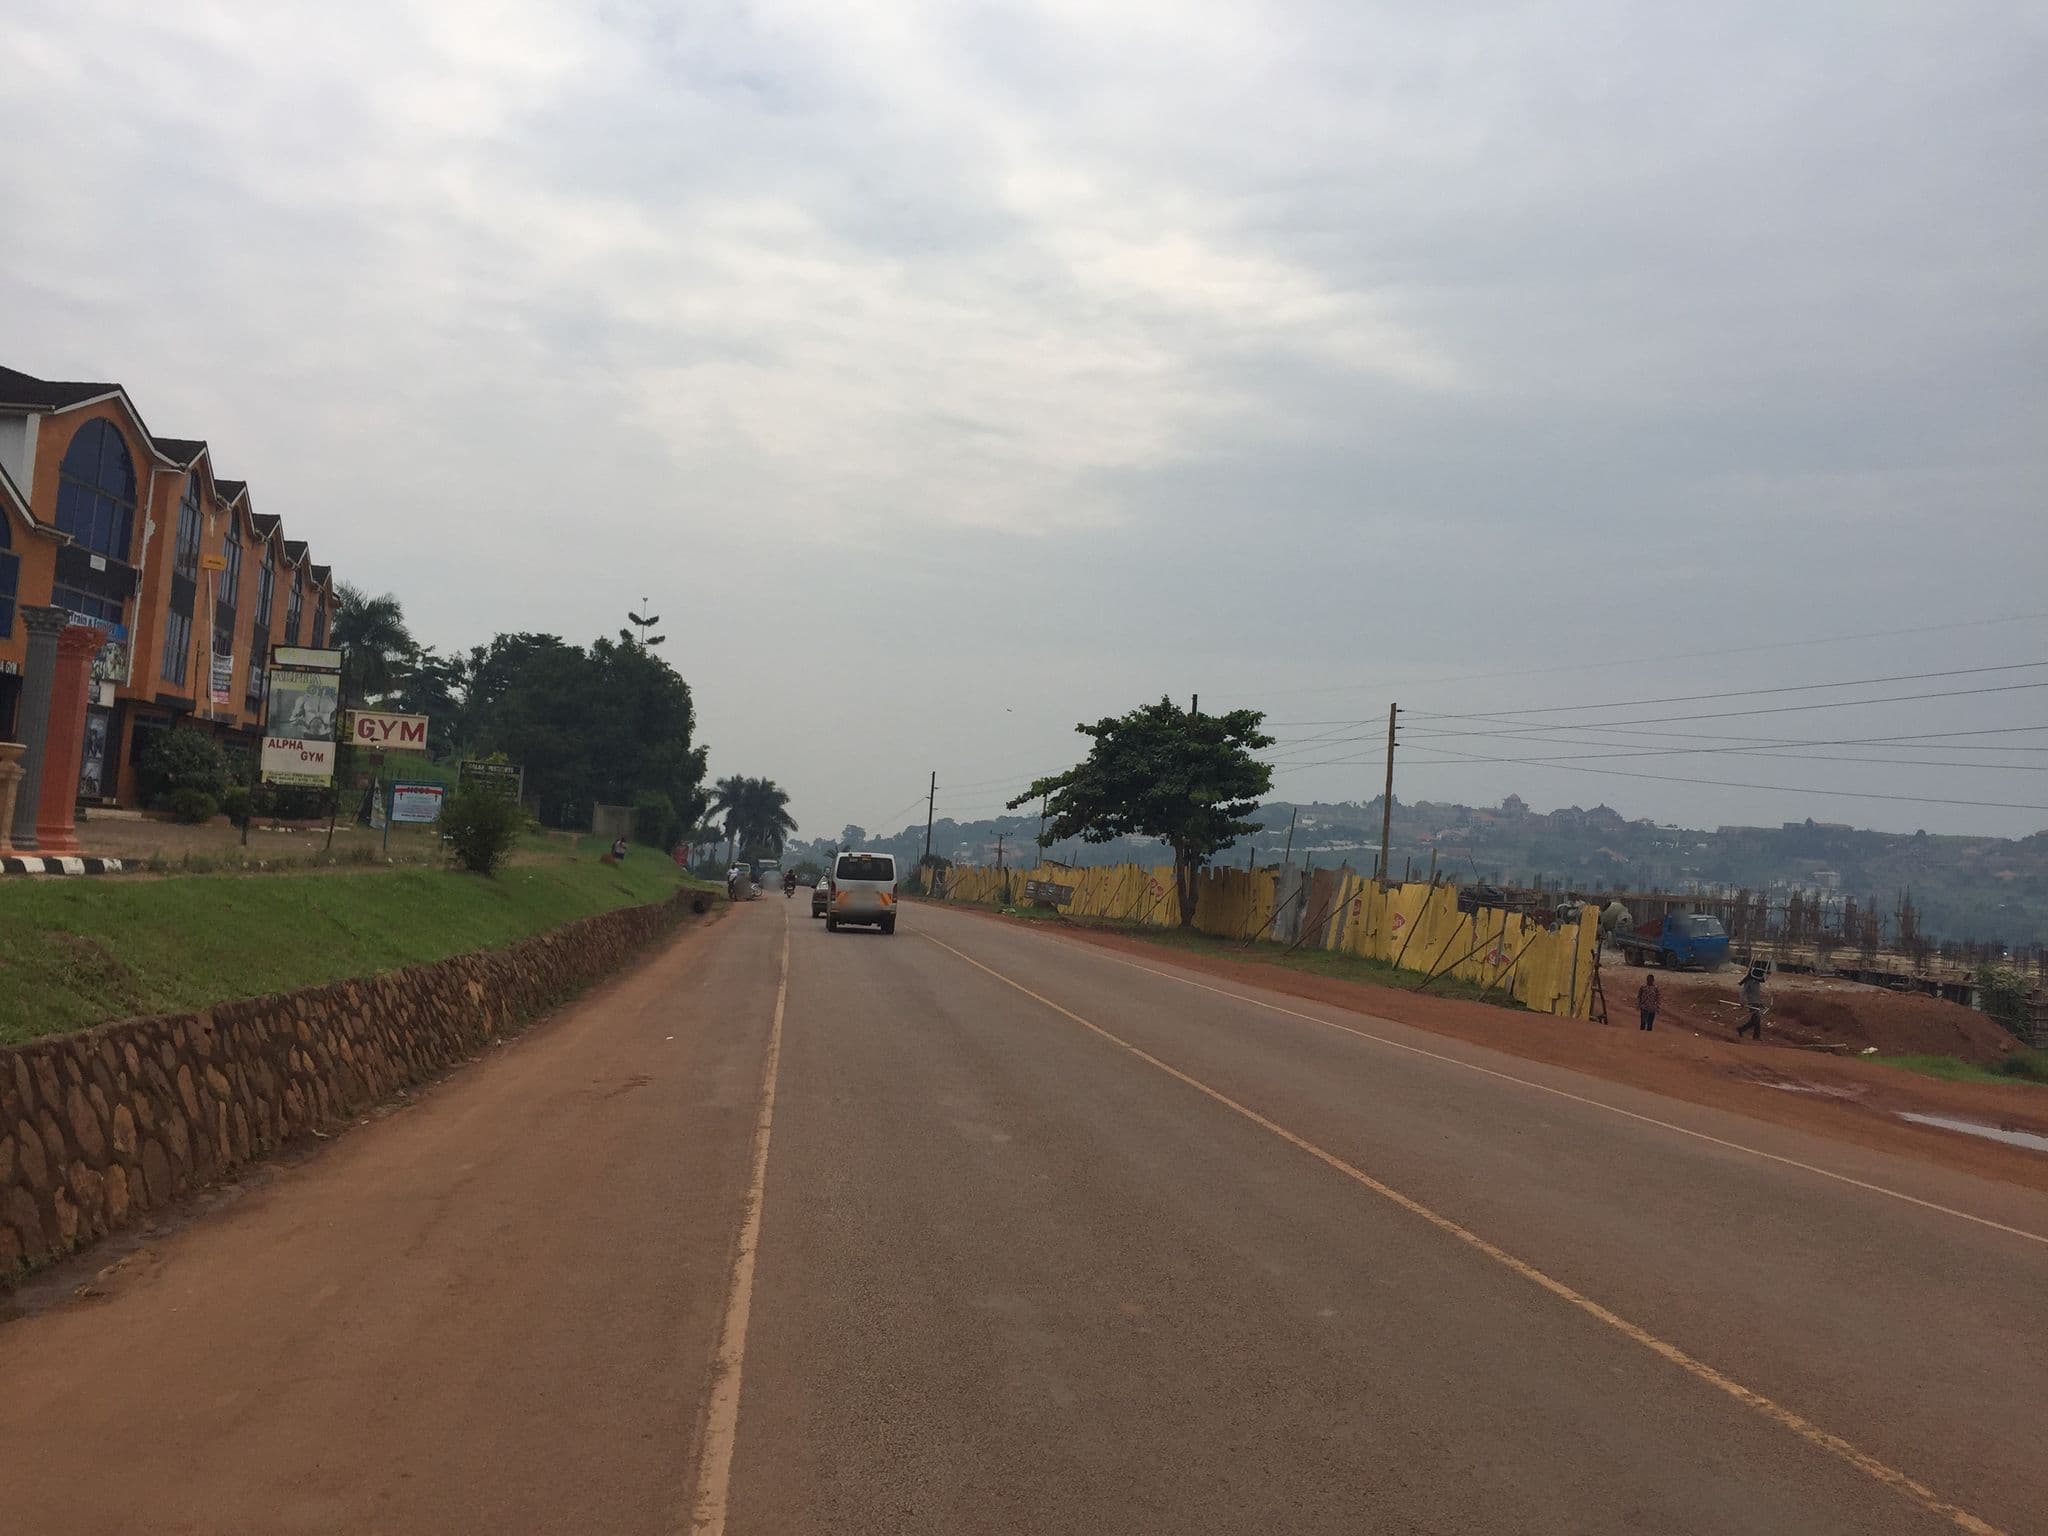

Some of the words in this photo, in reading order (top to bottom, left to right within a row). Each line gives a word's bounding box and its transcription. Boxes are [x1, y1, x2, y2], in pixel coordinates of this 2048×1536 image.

[358, 718, 425, 743] GYM
[268, 738, 304, 751] ALPHA
[300, 751, 324, 763] GYM
